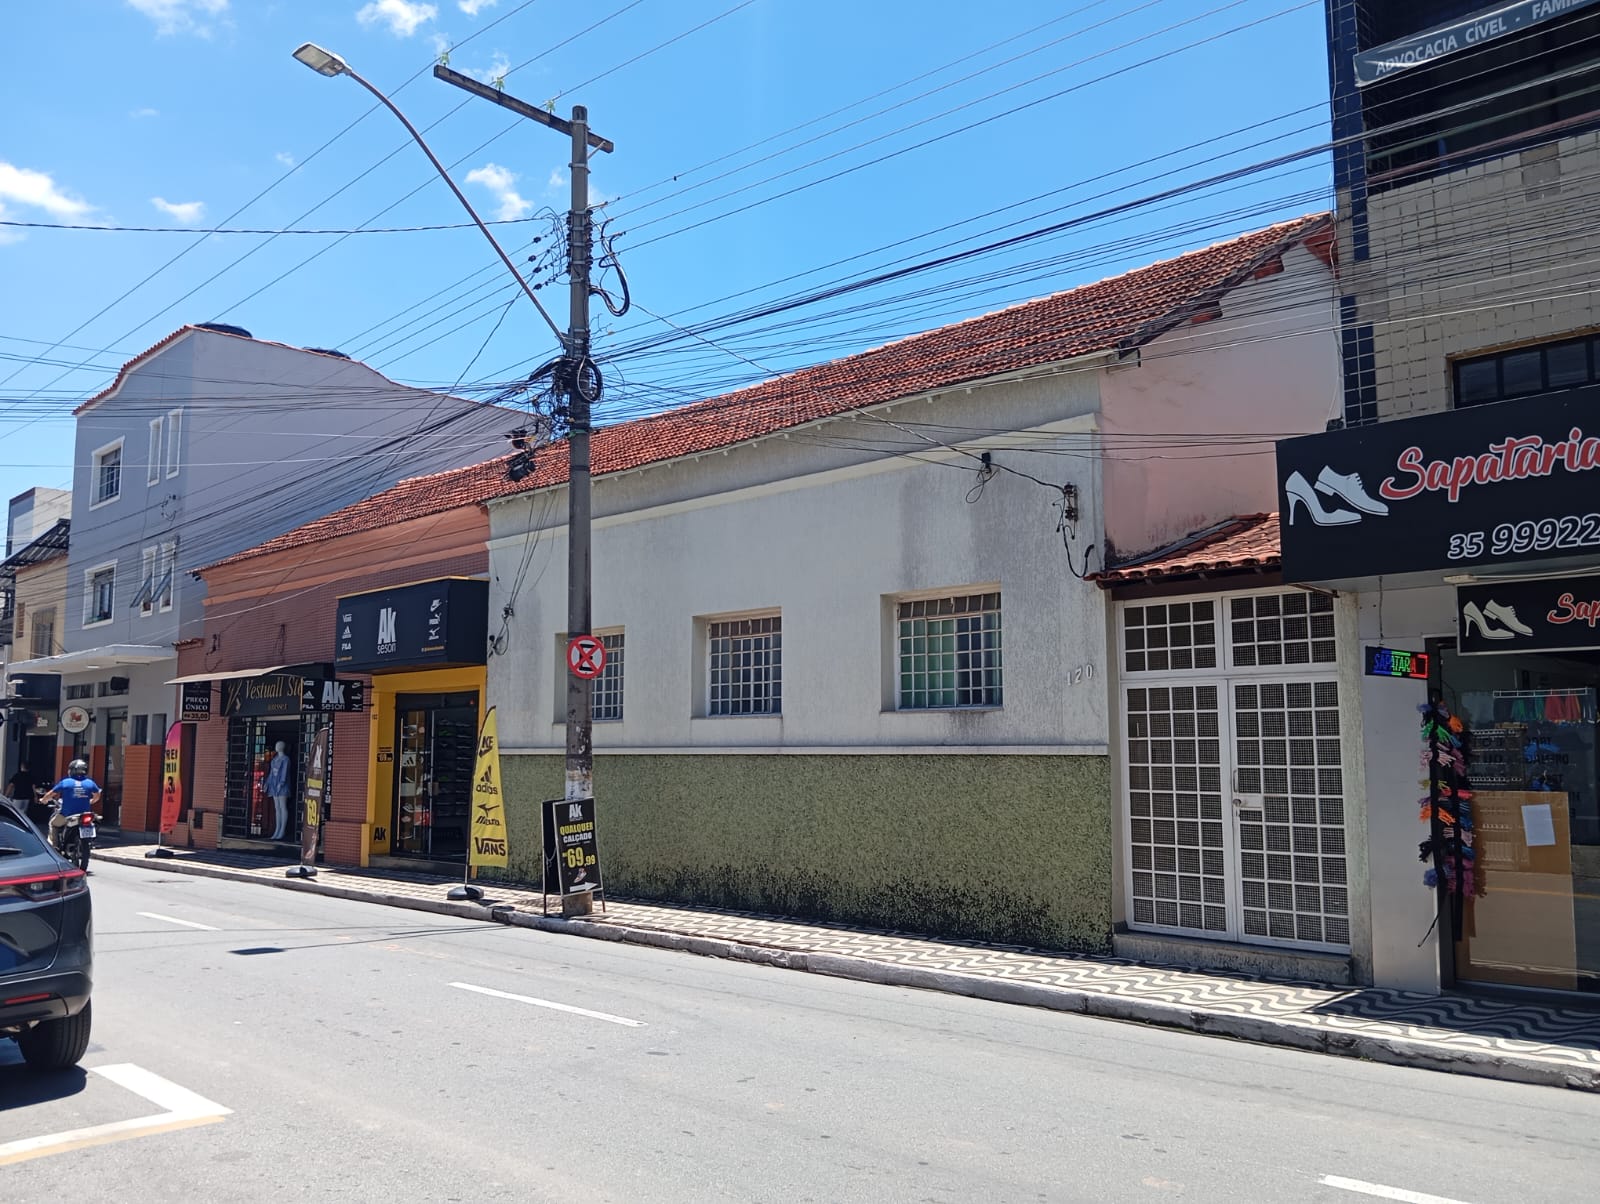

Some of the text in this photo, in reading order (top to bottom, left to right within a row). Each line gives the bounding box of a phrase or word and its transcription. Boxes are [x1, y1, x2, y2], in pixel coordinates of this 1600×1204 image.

[1375, 35, 1458, 76] ADVOCACIA
[1465, 22, 1507, 44] CÍVEL
[1379, 426, 1600, 502] Sapataria
[1447, 531, 1485, 559] 35
[1066, 664, 1094, 686] 120
[560, 822, 593, 836] QUALQUER
[563, 832, 593, 843] CALÇADO
